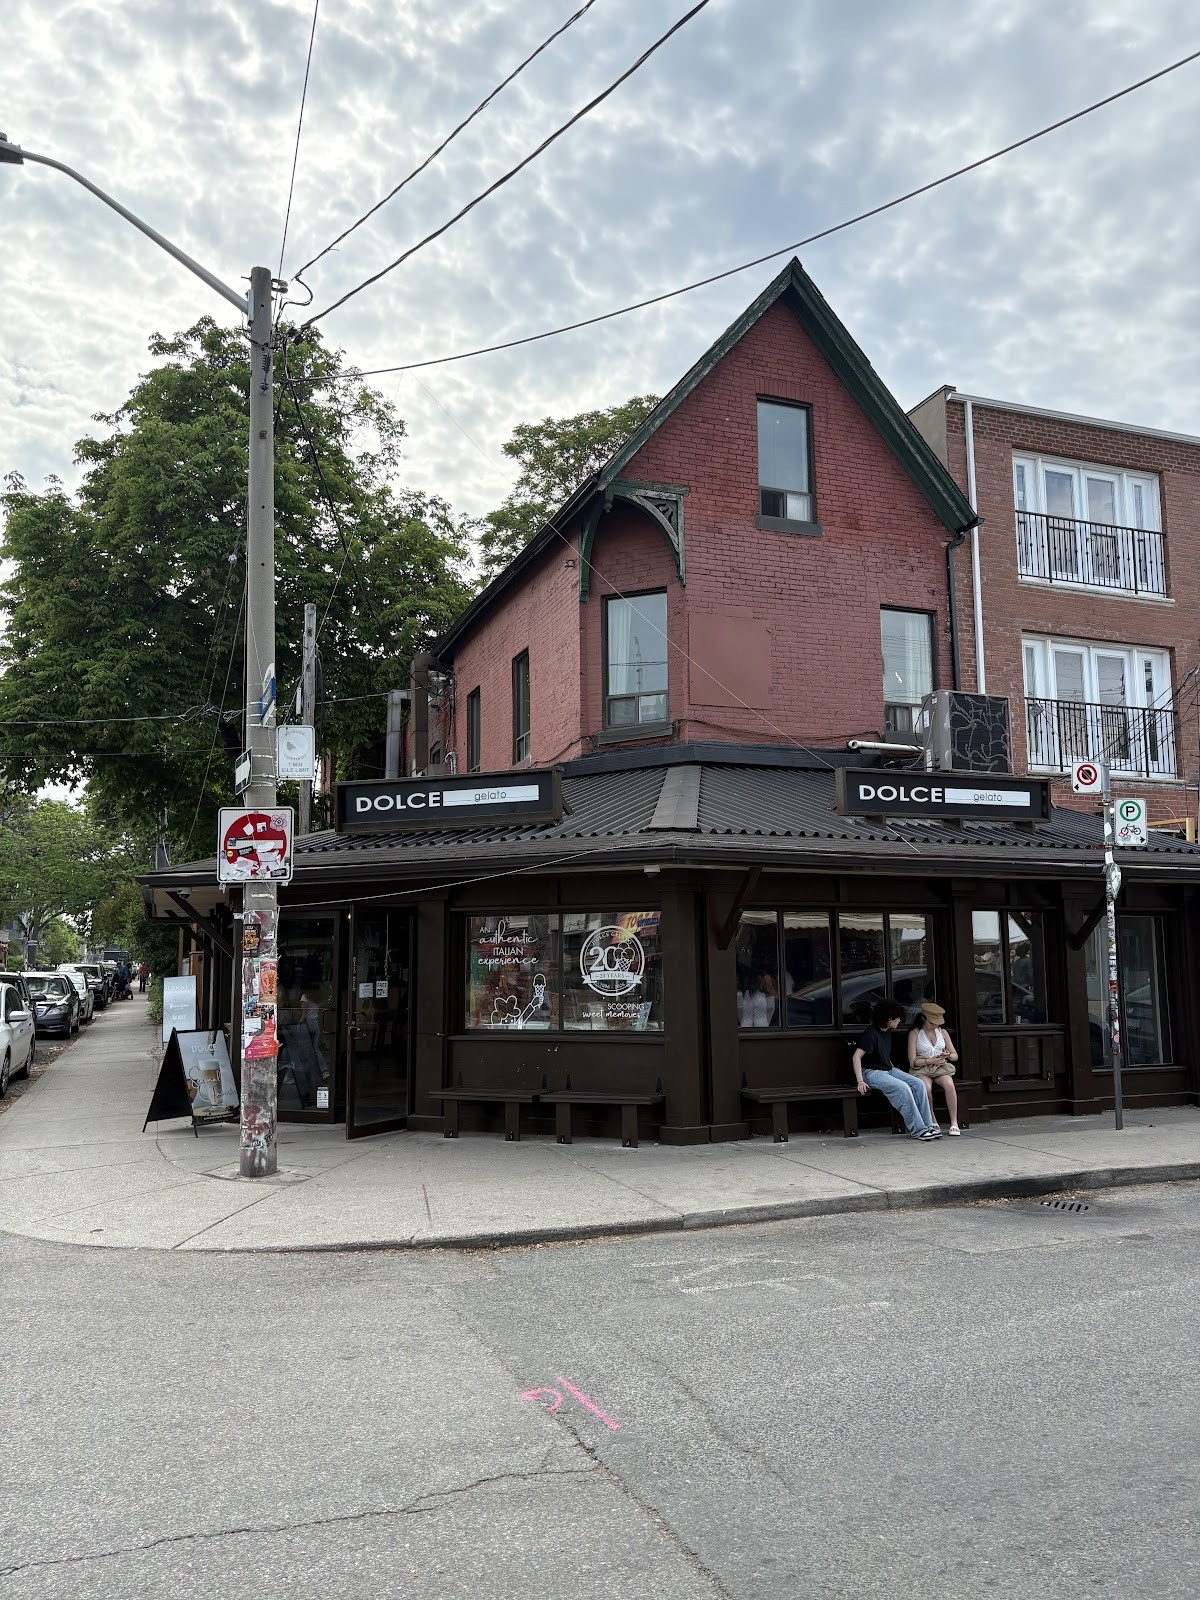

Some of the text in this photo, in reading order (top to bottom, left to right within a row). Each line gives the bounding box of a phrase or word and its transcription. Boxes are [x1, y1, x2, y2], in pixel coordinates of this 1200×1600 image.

[859, 784, 1003, 803] DOLCE gelato
[356, 790, 507, 813] DOLCE gelato
[1125, 806, 1135, 817] P
[479, 926, 491, 934] AN
[479, 920, 539, 944] authentic
[493, 946, 524, 956] ITALIAN
[478, 956, 540, 972] experience
[589, 946, 619, 971] 20
[582, 1006, 605, 1018] sweet
[607, 1002, 645, 1011] SCOOPING
[191, 1043, 218, 1053] DOLCE
